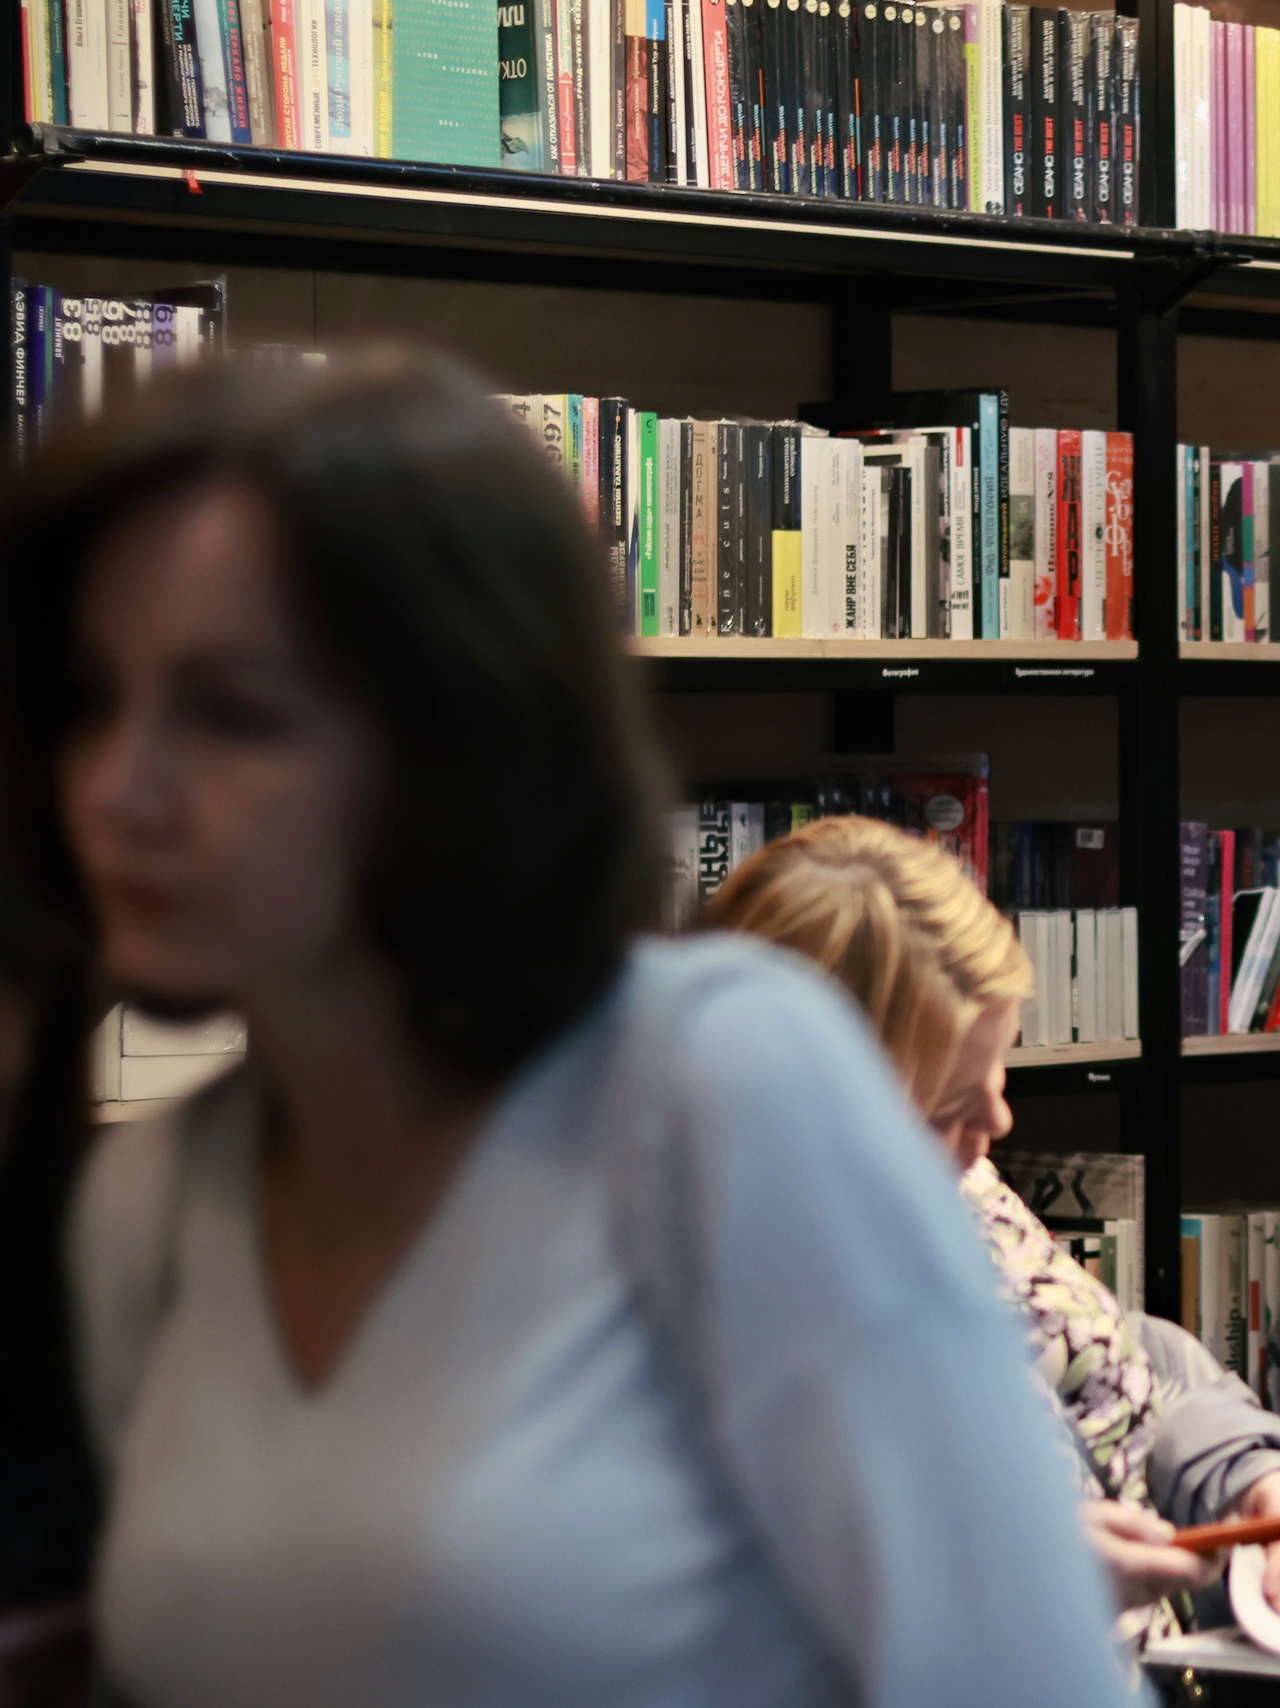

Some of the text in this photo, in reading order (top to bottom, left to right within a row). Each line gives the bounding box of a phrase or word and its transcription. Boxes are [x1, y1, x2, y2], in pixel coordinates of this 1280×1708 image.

[181, 0, 191, 18] ЧИ
[75, 27, 83, 47] Ольга
[544, 34, 554, 80] ПЛАСТИКА
[227, 0, 247, 128] ВОЕ ЗЕРКАЛО ЖИЗНИ
[331, 39, 345, 92] Русской
[547, 83, 554, 92] ОТ
[714, 30, 727, 103] КОНЦЕРТА
[280, 37, 293, 150] ДРУГАЯ СТОРОНА МЕДАЛИ
[334, 95, 345, 133] Люди
[548, 93, 558, 143] ОТКАЗАТЬСЯ
[717, 105, 728, 127] ДО
[312, 92, 322, 149] СОВРЕМЕННЫЕ
[550, 145, 558, 160] КАК
[1013, 113, 1025, 195] СЕАНС THE BEST
[1044, 117, 1055, 198] СЕАНС THE BEST
[1074, 119, 1085, 200] СЕАНС THE BEST
[1099, 122, 1109, 202] СЕАНС THE BEST
[1123, 125, 1133, 205] СЕАНС THE BEST
[14, 290, 26, 344] ДЭВИД
[54, 318, 62, 358] ORNAMENT
[63, 299, 82, 341] 83
[85, 299, 102, 336] 85
[101, 300, 121, 345] 86
[119, 302, 136, 342] 87
[135, 304, 153, 350] 88
[154, 305, 174, 346] 89
[15, 347, 26, 406] ФИНЧЕР
[614, 435, 622, 486] ТАРАНТИНО
[999, 390, 1009, 573] ФОТОГРАФИРУЙ ИДЕАЛЬНУЮ ЕДУ
[720, 487, 731, 548] cuts
[955, 516, 965, 549] ВРЕМЯ
[1061, 455, 1081, 597] ЖАР
[845, 545, 857, 629] ЖАНР ВНЕ СЕБЯ
[956, 552, 966, 586] САМОЕ
[720, 571, 731, 633] Fine
